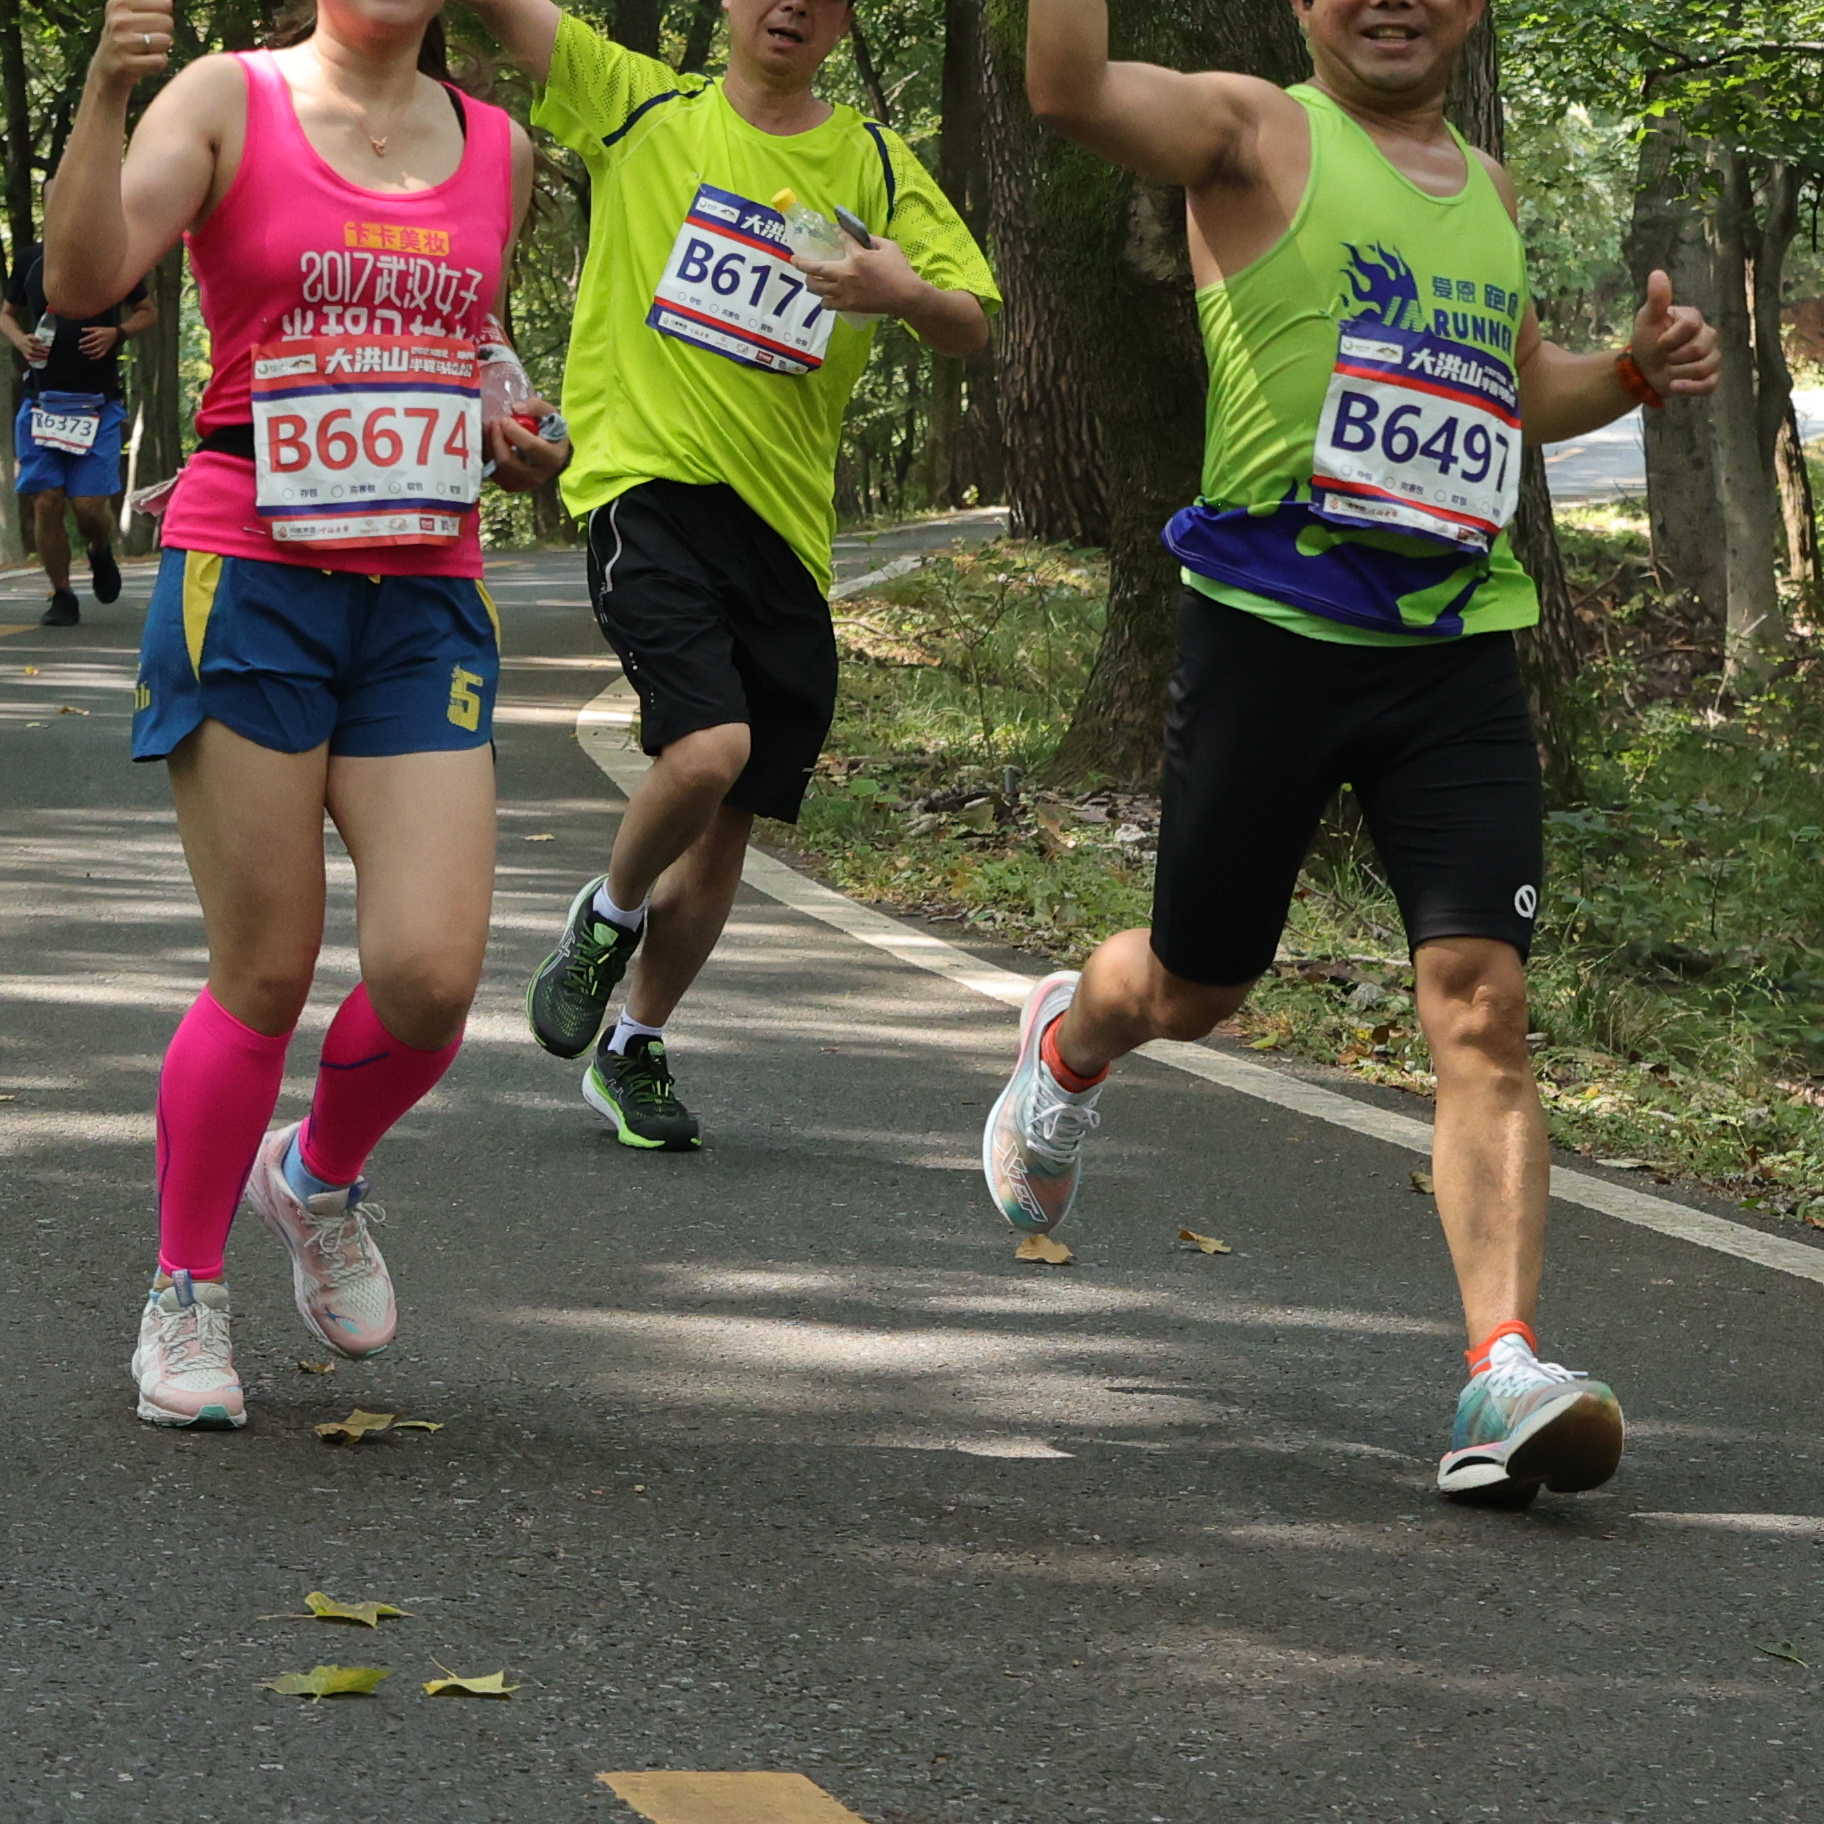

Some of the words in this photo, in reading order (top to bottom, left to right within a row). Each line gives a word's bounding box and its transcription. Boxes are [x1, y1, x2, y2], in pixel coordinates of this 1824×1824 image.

[740, 213, 787, 244] 大洪
[300, 250, 484, 320] 2017武汉女子
[324, 346, 409, 375] 大洪山
[1407, 347, 1484, 389] 大洪山
[266, 407, 470, 474] B6674
[1330, 389, 1510, 494] B6497
